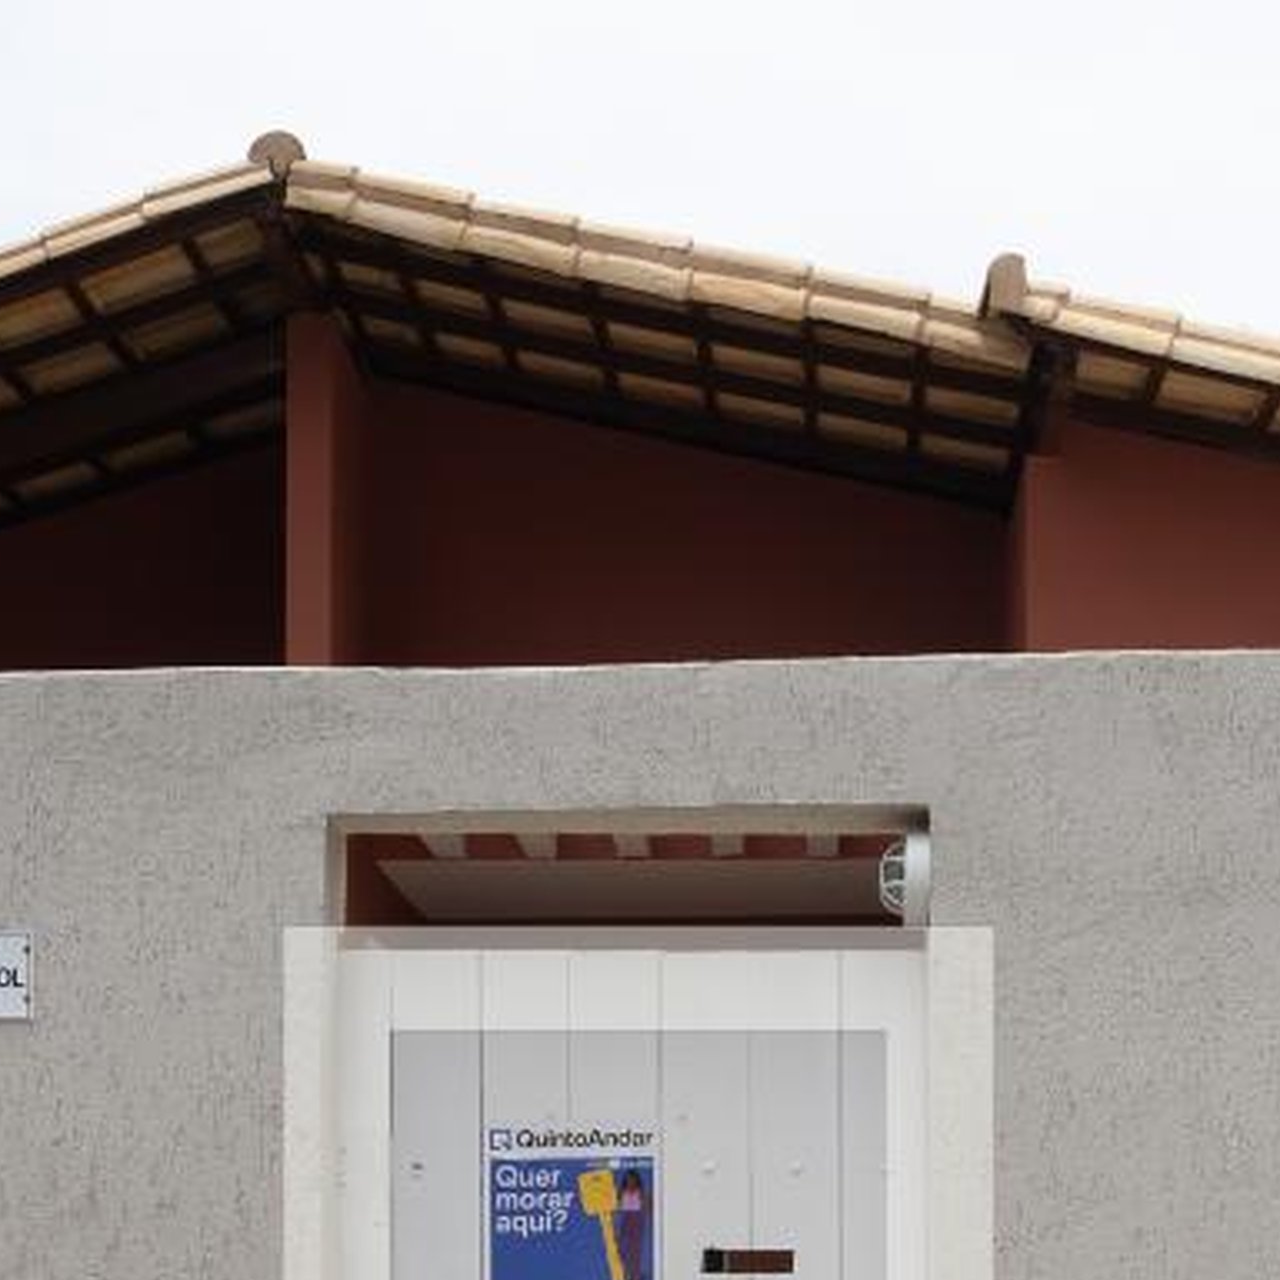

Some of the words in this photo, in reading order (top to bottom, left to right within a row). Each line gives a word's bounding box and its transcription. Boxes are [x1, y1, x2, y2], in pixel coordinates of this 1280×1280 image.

[516, 1128, 654, 1148] QuintoAndar
[496, 1164, 561, 1188] Quer
[496, 1192, 575, 1211] morar
[496, 1209, 568, 1238] aqui?
